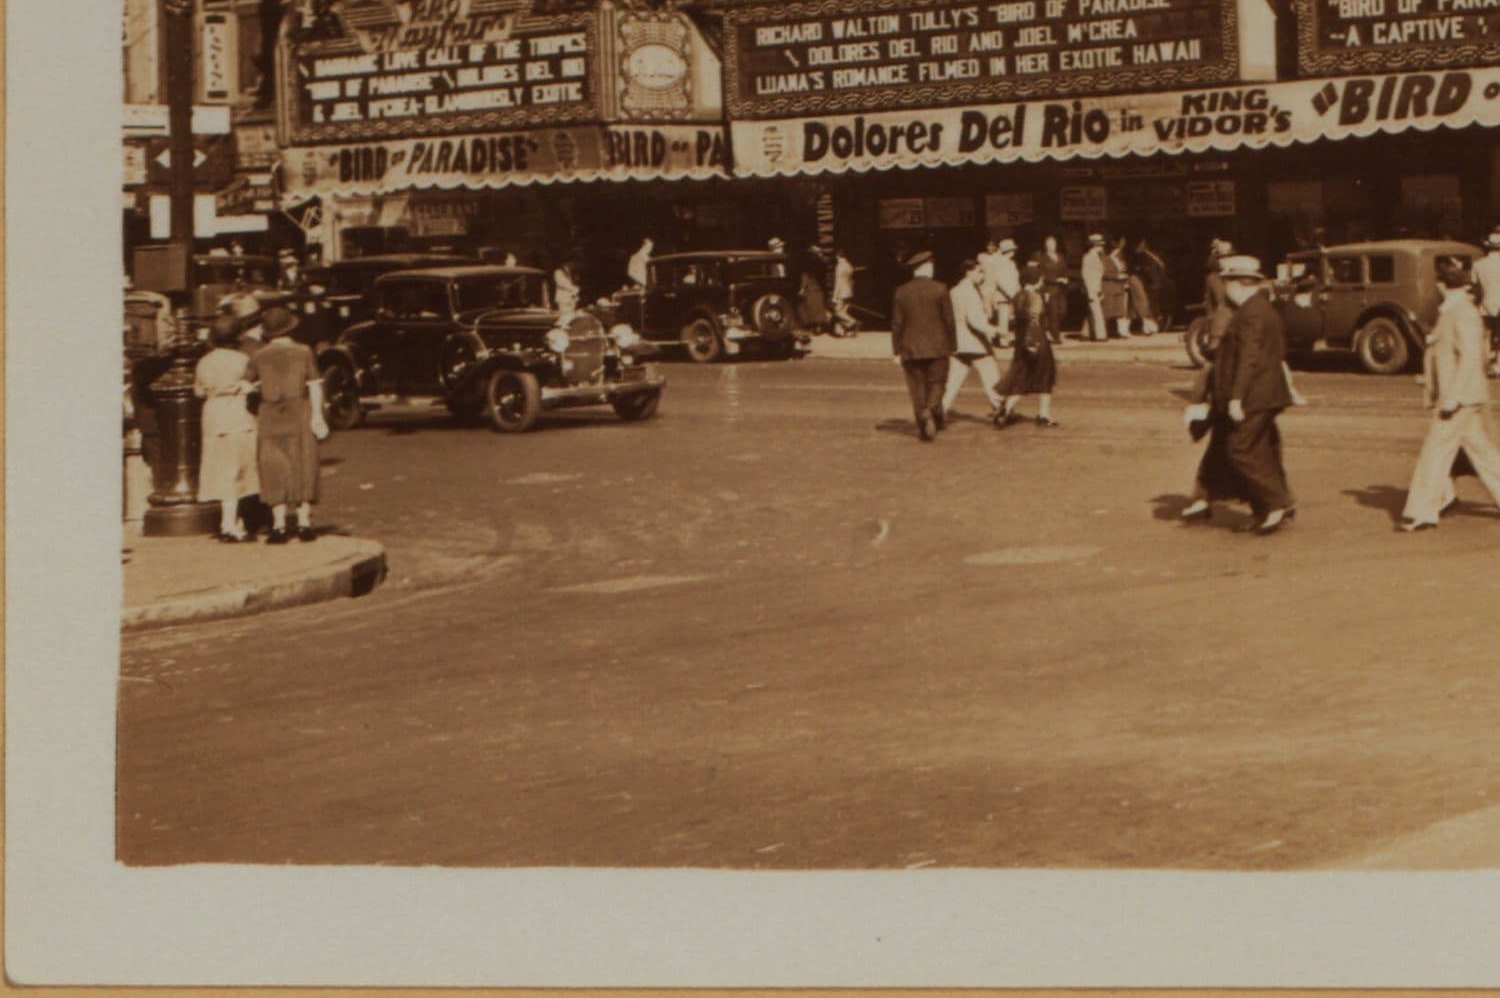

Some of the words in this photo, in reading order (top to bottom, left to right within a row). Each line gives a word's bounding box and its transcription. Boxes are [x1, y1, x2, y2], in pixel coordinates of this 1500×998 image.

[756, 21, 823, 47] RICHARD
[831, 14, 900, 40] WALTON
[909, 6, 979, 31] TULLY'S
[988, 0, 1036, 23] "BIRD
[1373, 16, 1465, 45] CAPTIVE
[807, 41, 881, 66] DOLORES
[888, 37, 921, 59] DEL
[930, 33, 958, 56] RIO
[969, 29, 1003, 52] AND
[1013, 25, 1057, 48] JOEL
[756, 71, 825, 95] LUANA'S
[832, 64, 910, 89] ROMANCE
[918, 57, 981, 82] FILMED
[989, 55, 1006, 77] IN
[1015, 52, 1050, 74] HER
[1059, 45, 1123, 71] EXOTIC
[1132, 38, 1202, 64] HAWAII
[1180, 88, 1269, 116] KING
[1311, 71, 1474, 127] "BIRD
[802, 115, 944, 163] Dolores
[958, 103, 1026, 154] Del
[1040, 100, 1111, 148] Rio
[1119, 107, 1144, 133] in
[1152, 105, 1293, 143] VIDOR'S
[696, 130, 725, 169] PA
